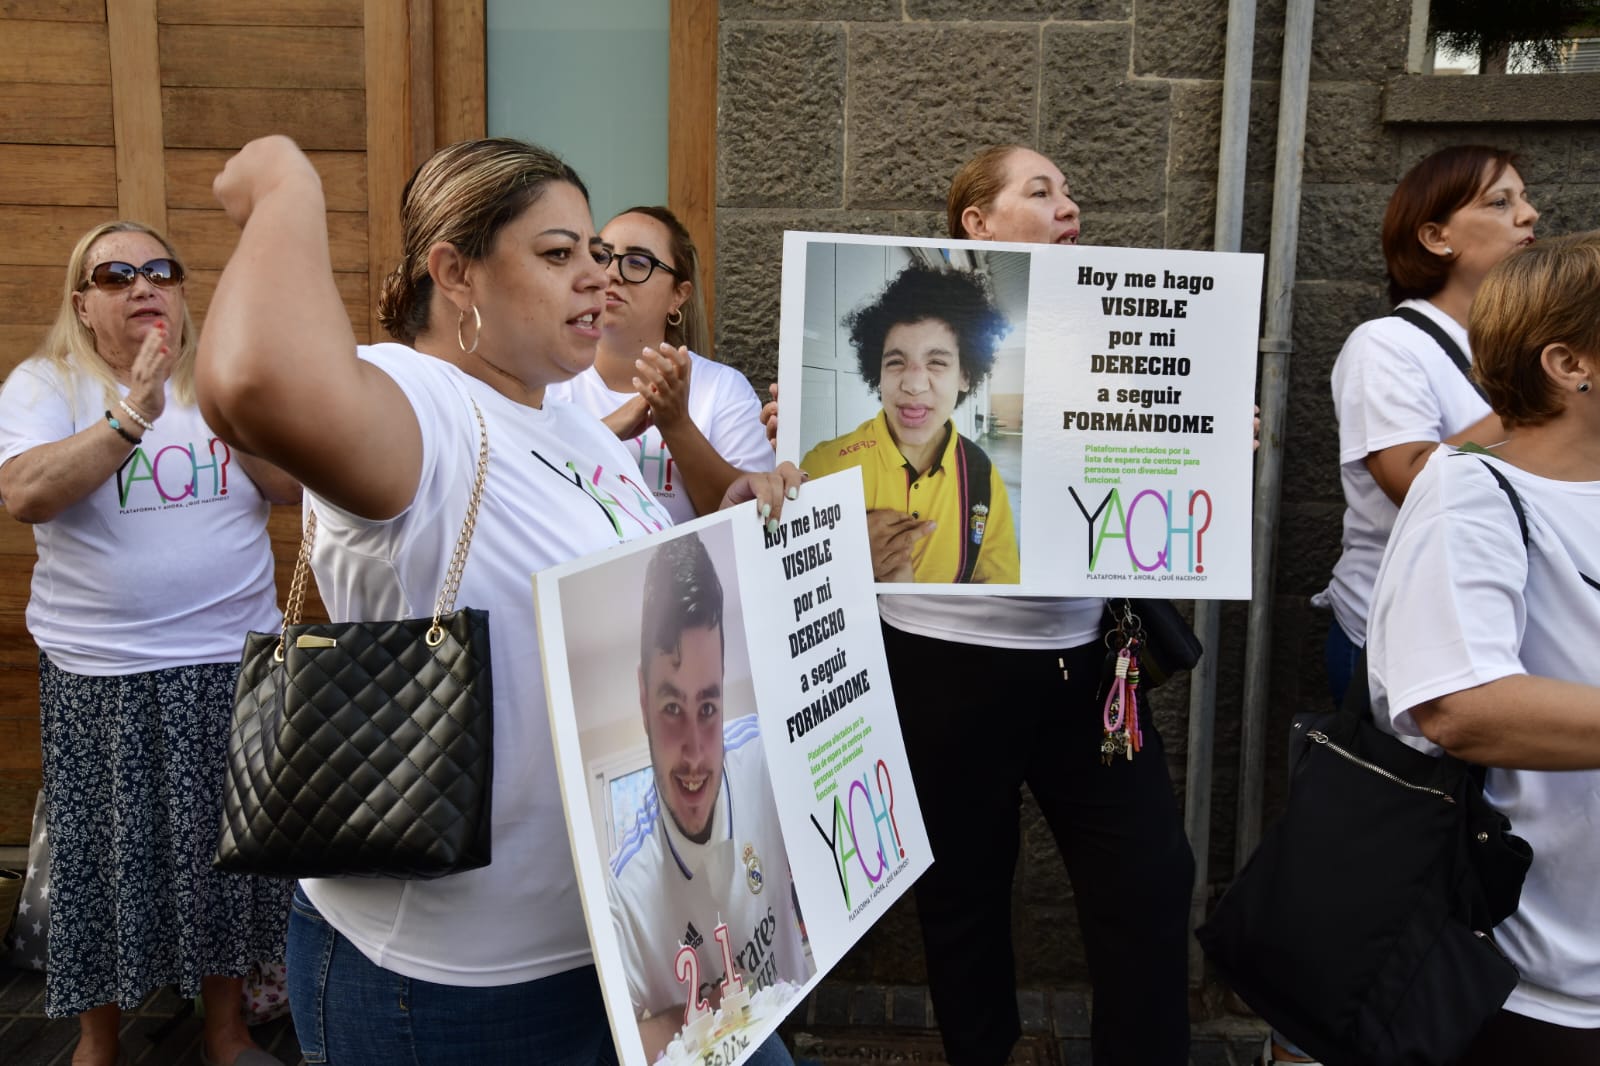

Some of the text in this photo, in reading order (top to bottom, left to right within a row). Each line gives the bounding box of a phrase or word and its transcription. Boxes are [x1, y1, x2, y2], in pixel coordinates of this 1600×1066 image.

[1078, 266, 1214, 295] Hoy me hago
[1102, 297, 1188, 318] VISIBLE
[1108, 329, 1175, 350] por mi
[1091, 354, 1190, 376] DERECHO
[1097, 386, 1182, 408] a seguir
[1063, 409, 1214, 434] FORMÁNDOME
[1085, 444, 1127, 454] Plataforma
[1129, 446, 1166, 454] afectados
[1168, 448, 1181, 456] por
[1084, 466, 1120, 474] personas
[1138, 467, 1178, 475] diversidad
[791, 516, 810, 539] me
[812, 504, 841, 530] hago
[1068, 486, 1212, 574] YAQH?
[782, 538, 832, 580] VISIBLE
[1158, 574, 1174, 582] ¿QUÉ
[793, 576, 832, 622] por mi
[788, 607, 846, 659] DERECHO
[800, 648, 847, 693] a seguir
[786, 668, 871, 744] FORMÁNDOME
[810, 759, 905, 912] YAQH?
